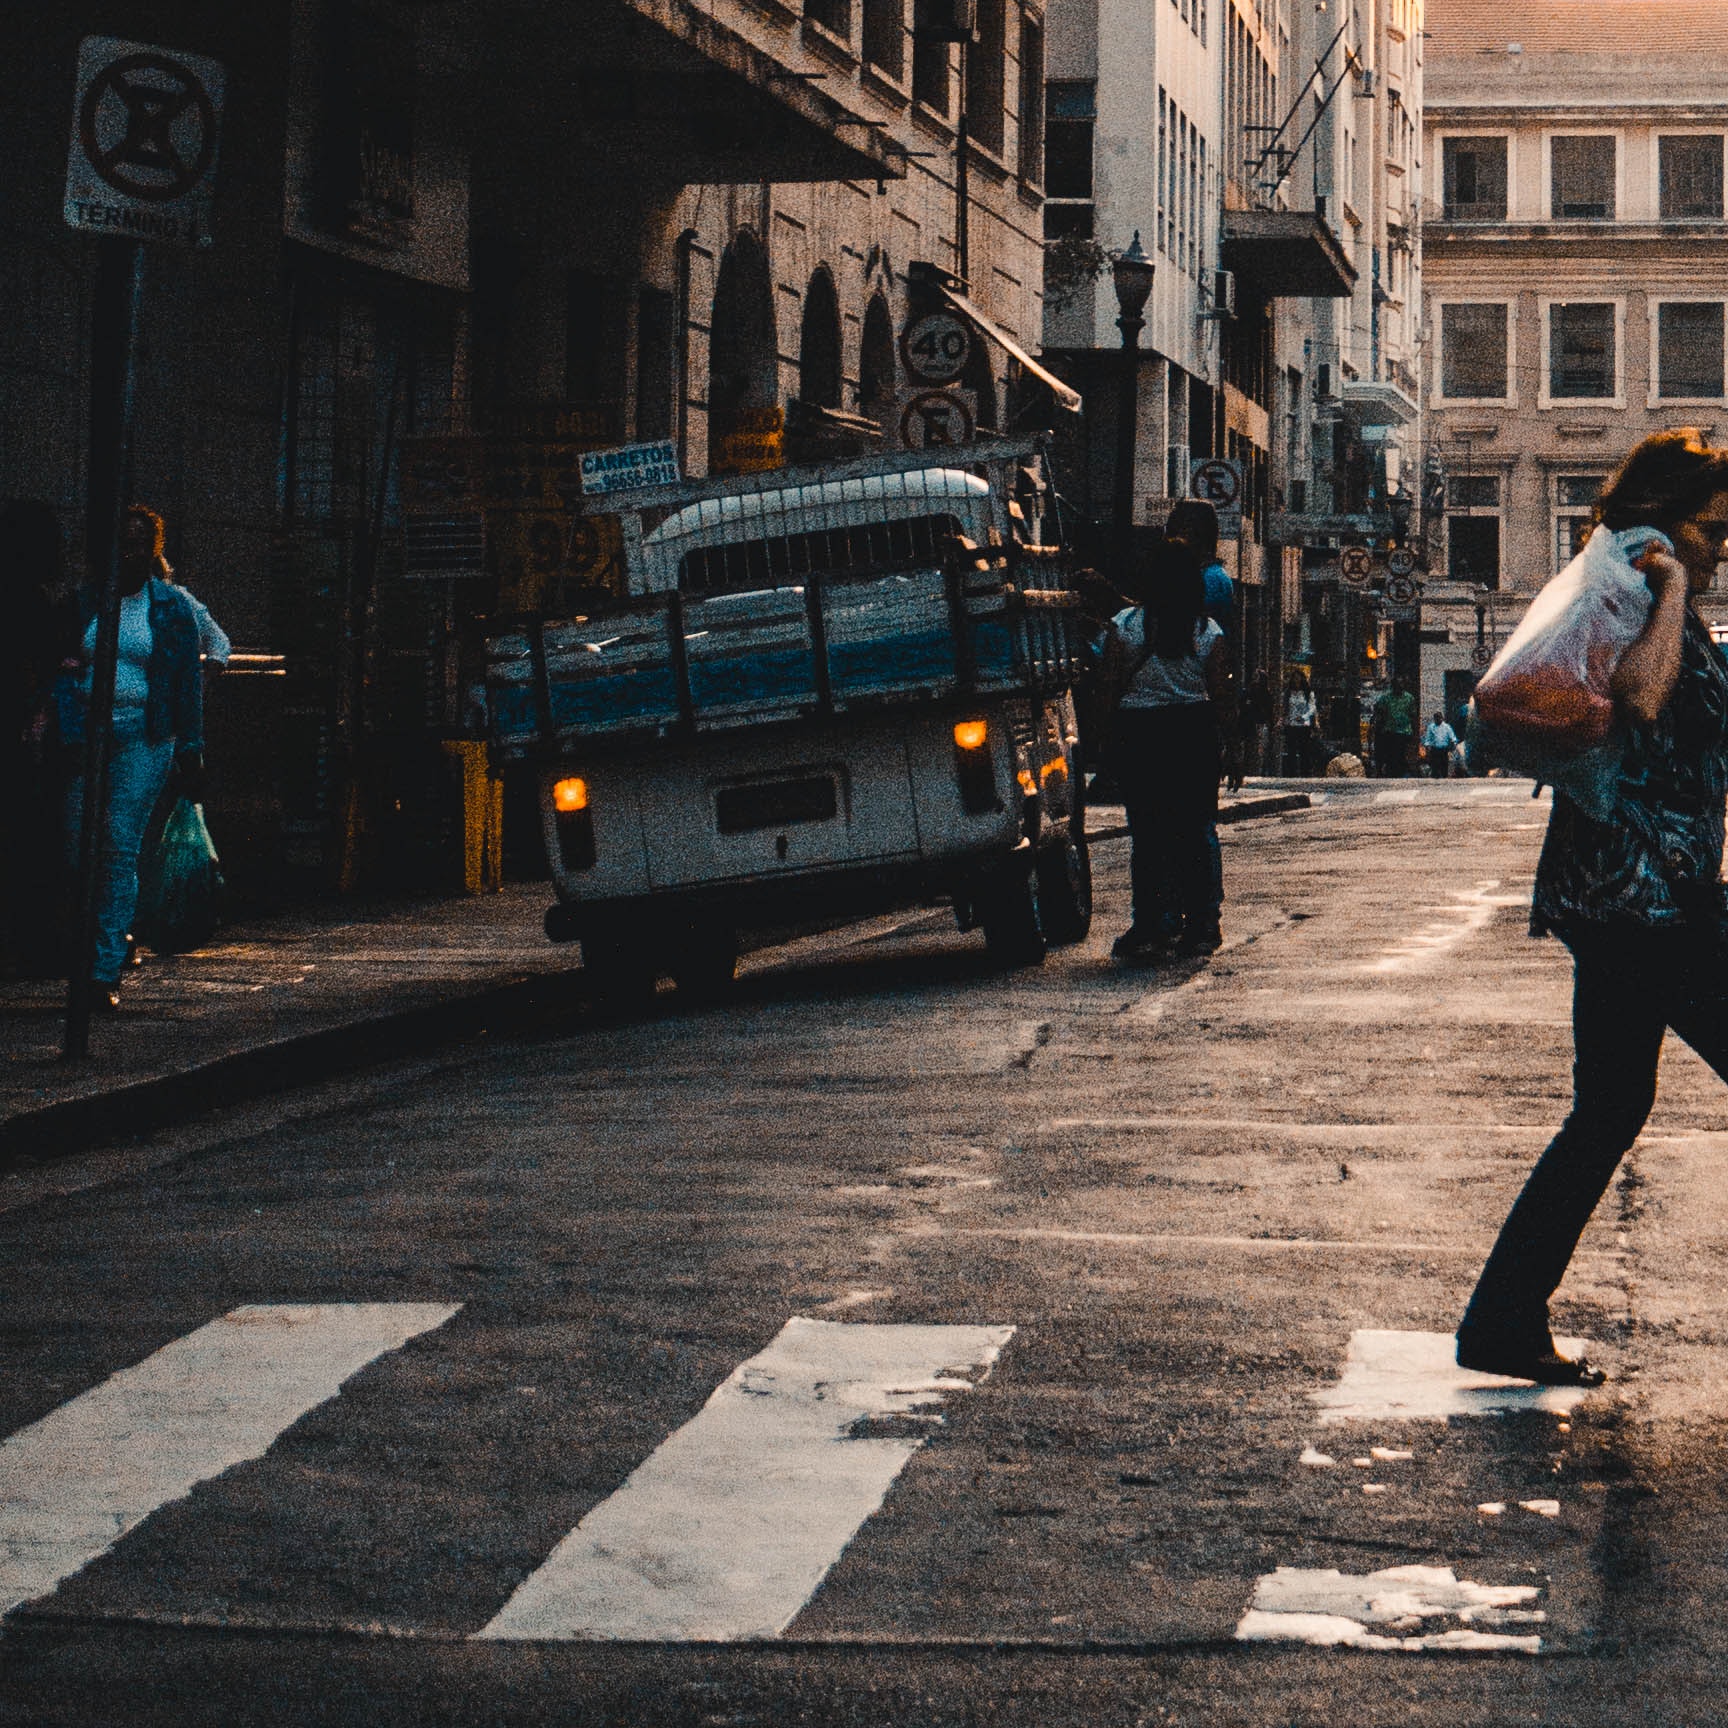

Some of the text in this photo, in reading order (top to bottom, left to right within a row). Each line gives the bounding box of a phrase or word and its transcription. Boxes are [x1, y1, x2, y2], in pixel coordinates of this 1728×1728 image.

[76, 199, 178, 236] TÉRMINO
[912, 330, 964, 359] 40
[582, 444, 673, 474] CARRETOS
